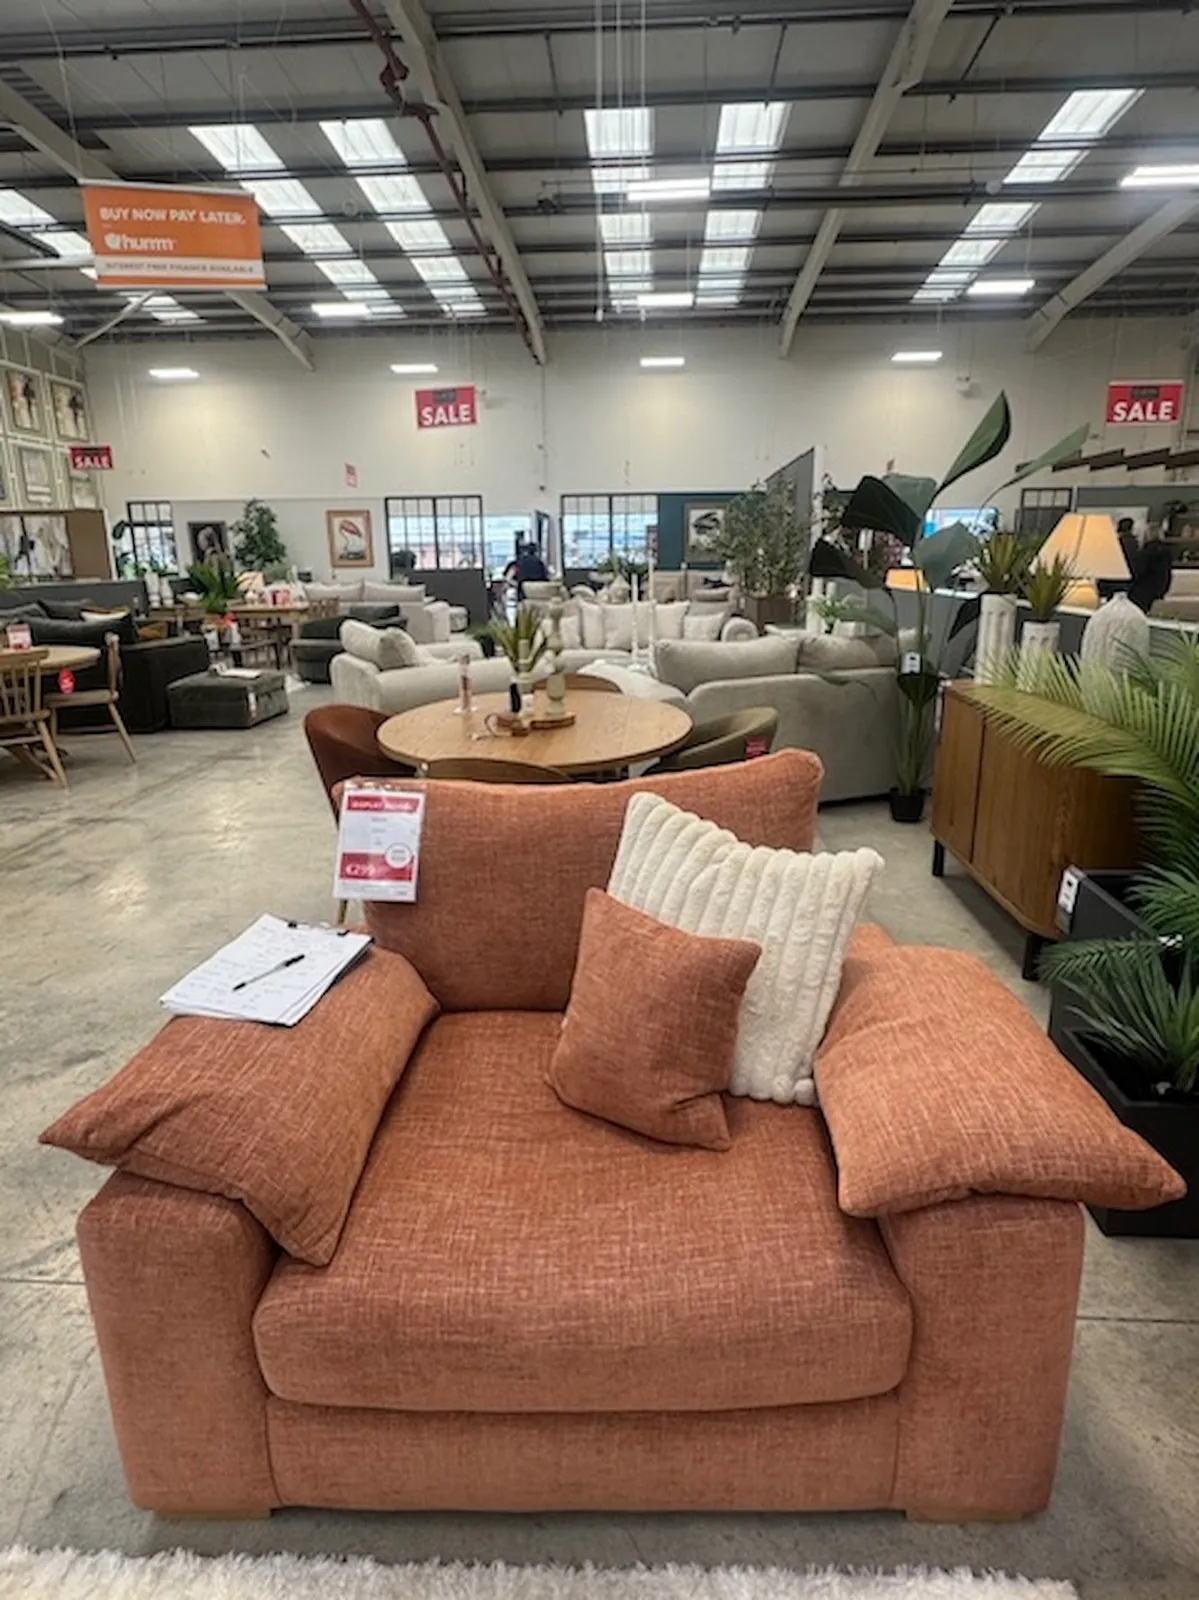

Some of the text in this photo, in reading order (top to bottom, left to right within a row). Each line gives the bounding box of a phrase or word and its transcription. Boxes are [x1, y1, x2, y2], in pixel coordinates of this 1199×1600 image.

[99, 206, 129, 221] BUY
[132, 208, 167, 221] NOW
[169, 208, 196, 222] PAY
[421, 404, 472, 426] SALE
[1112, 400, 1174, 421] SALE
[74, 455, 110, 468] SALE
